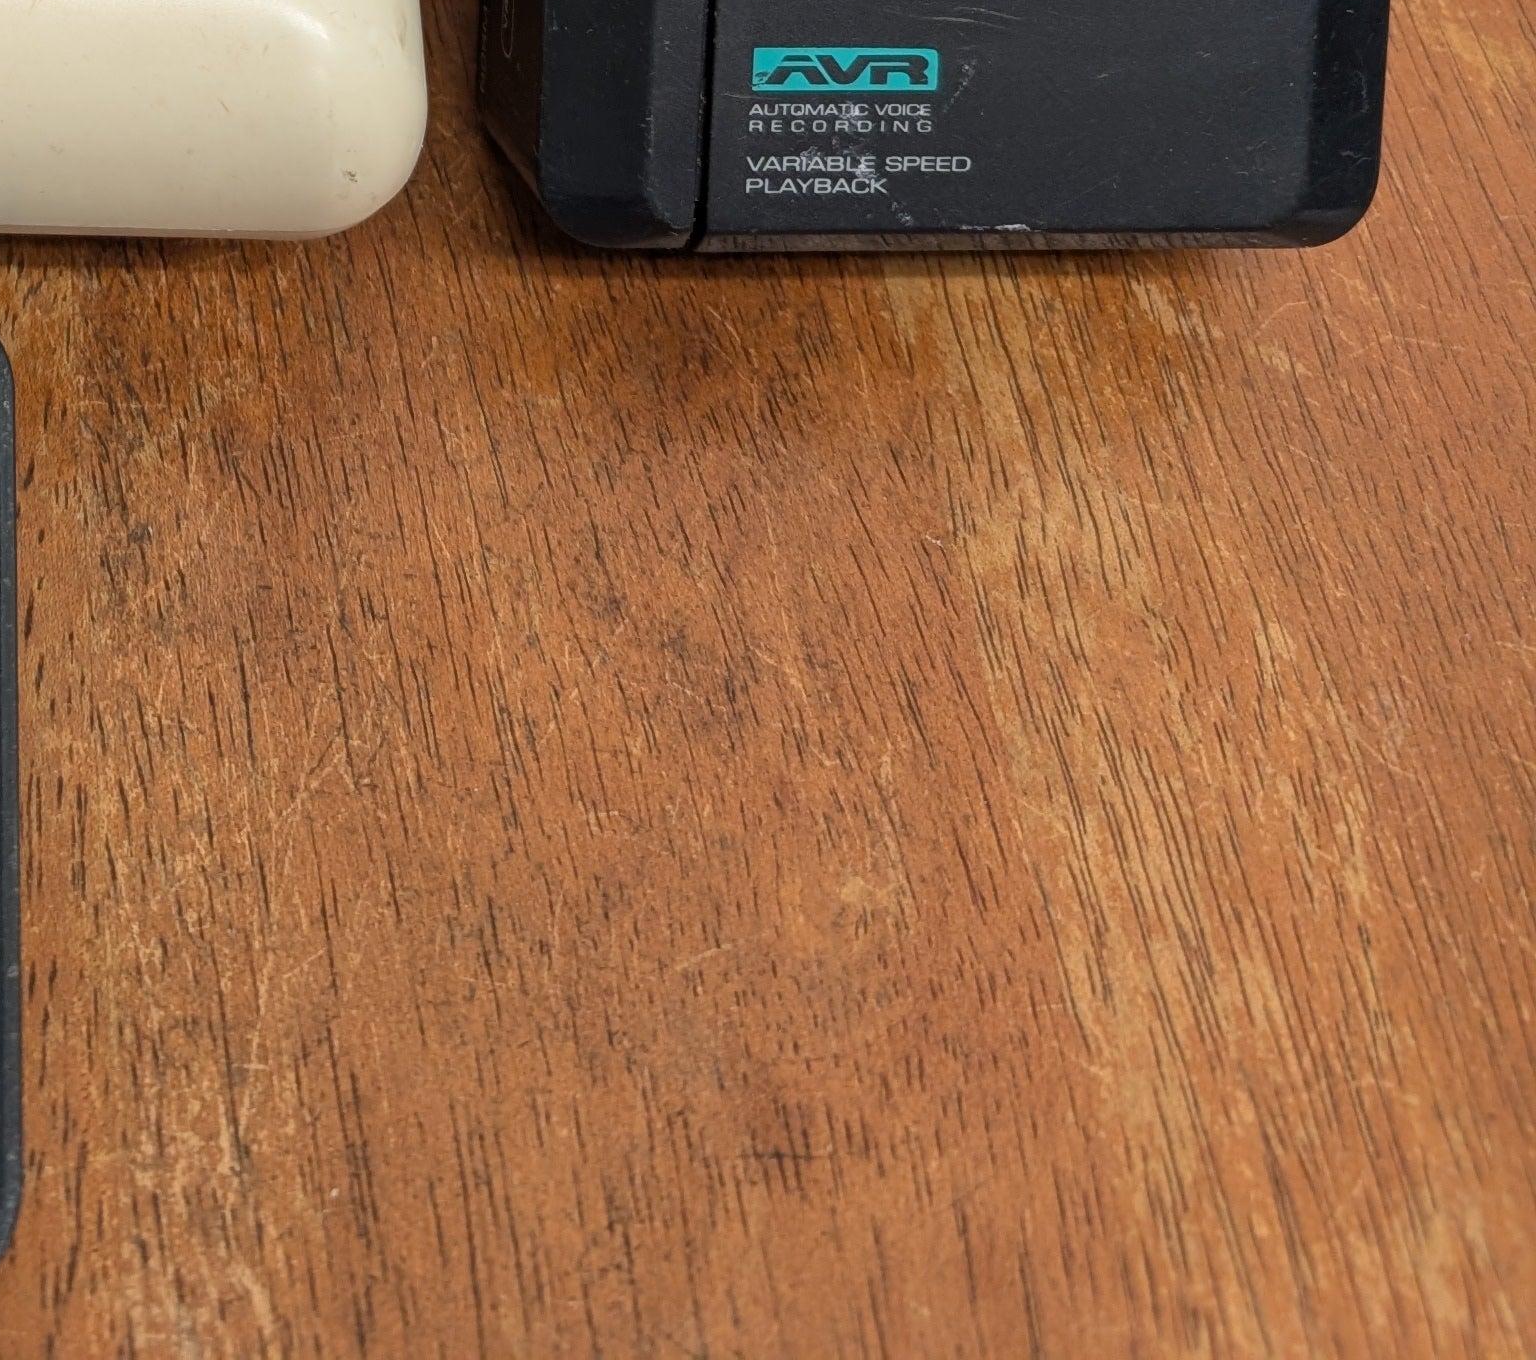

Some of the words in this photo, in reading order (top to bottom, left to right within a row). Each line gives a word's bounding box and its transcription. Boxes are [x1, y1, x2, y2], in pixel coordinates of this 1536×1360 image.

[763, 54, 930, 86] AVR
[748, 103, 869, 118] AUTOMATIC
[874, 103, 932, 118] VOICE
[748, 119, 933, 134] RECORDING
[745, 155, 877, 173] VARIABLE
[884, 155, 972, 173] SPEED
[744, 177, 888, 195] PLAYBACK
